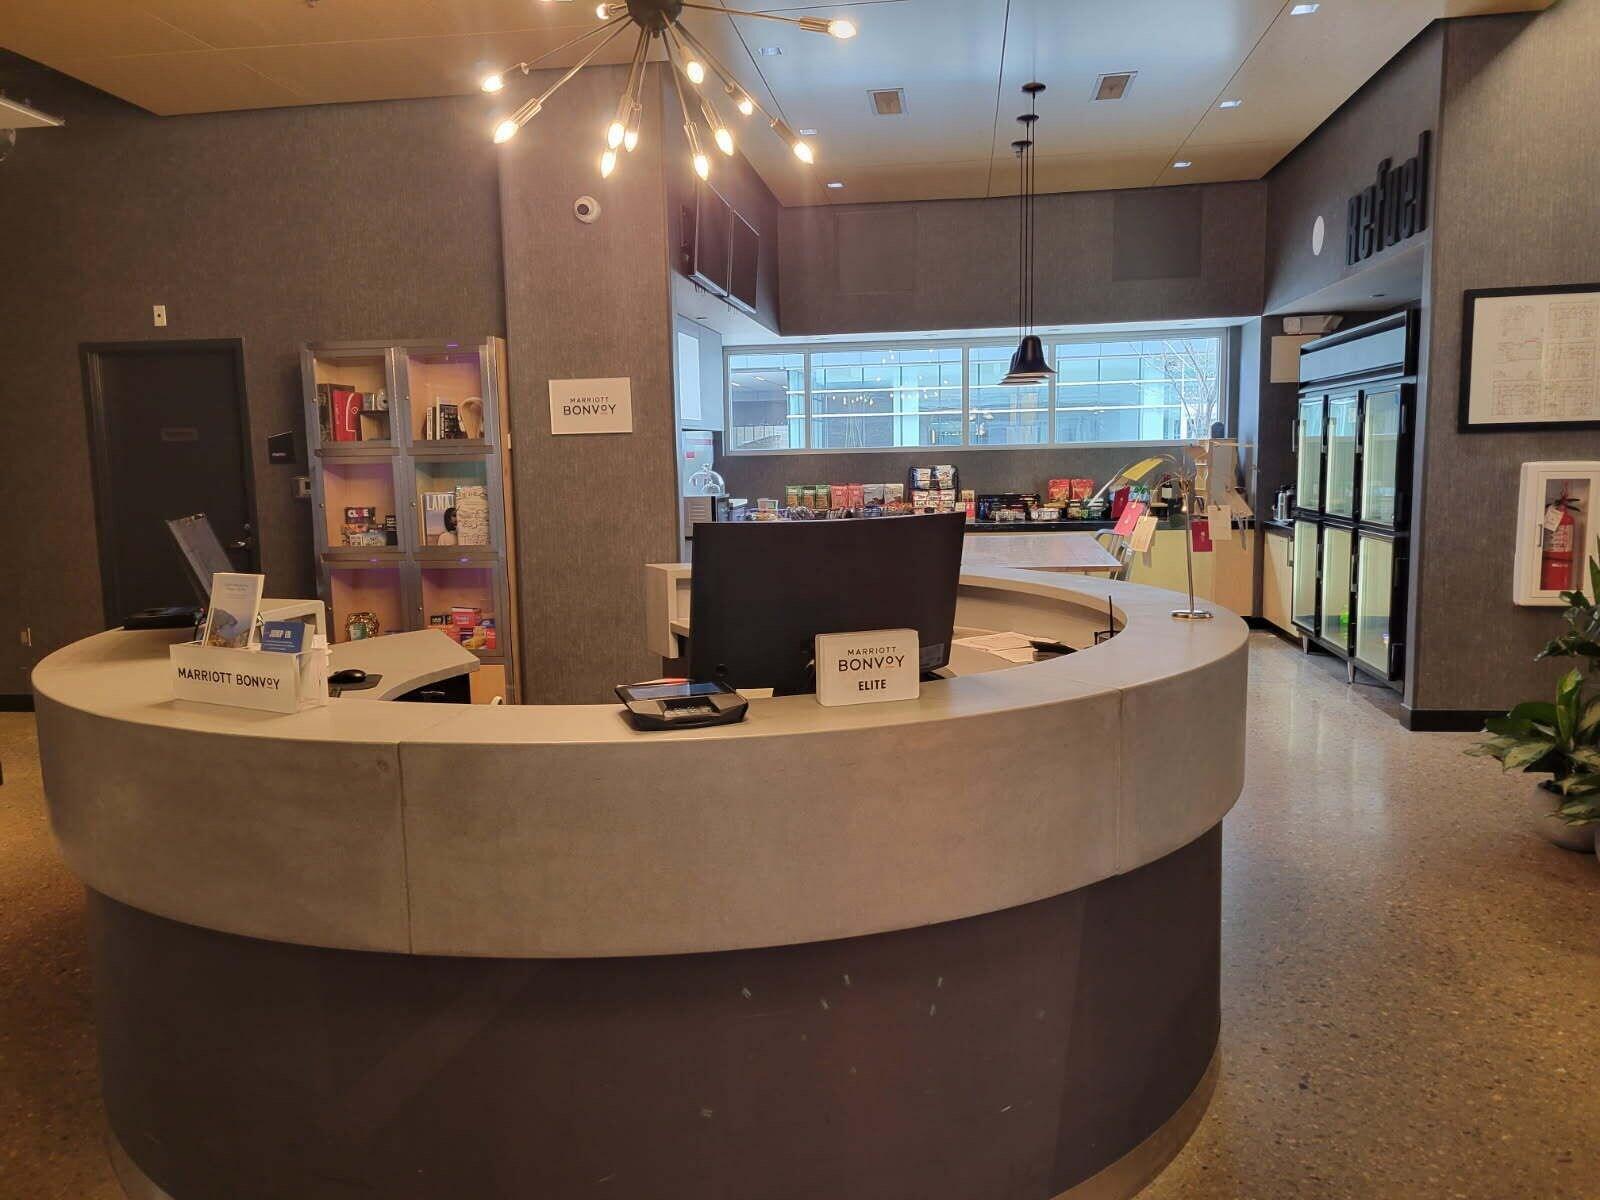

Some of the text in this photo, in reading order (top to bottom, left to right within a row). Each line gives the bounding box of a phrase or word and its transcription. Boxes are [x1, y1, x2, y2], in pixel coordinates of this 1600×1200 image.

[1346, 129, 1432, 265] Refuel
[847, 646, 897, 656] MARRIOTT
[177, 667, 233, 685] MARRIOTT
[858, 679, 887, 692] ELITE
